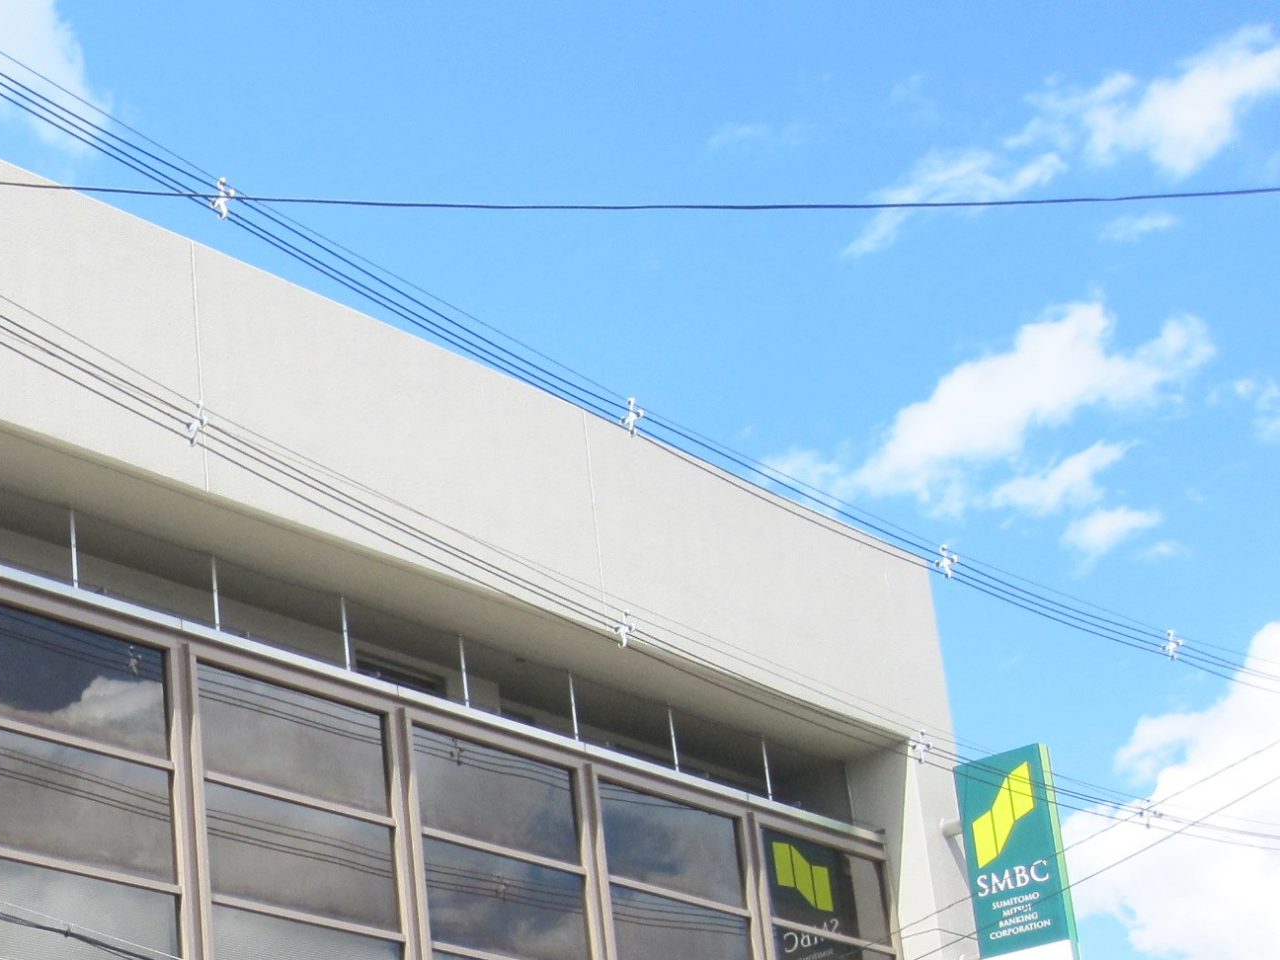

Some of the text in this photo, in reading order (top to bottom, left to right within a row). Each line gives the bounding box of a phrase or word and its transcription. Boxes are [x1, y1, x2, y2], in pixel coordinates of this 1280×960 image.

[976, 859, 1050, 897] SMBC
[991, 891, 1040, 910] SUMITOMO
[989, 918, 1051, 940] CORPORATION
[998, 911, 1039, 929] BANKING
